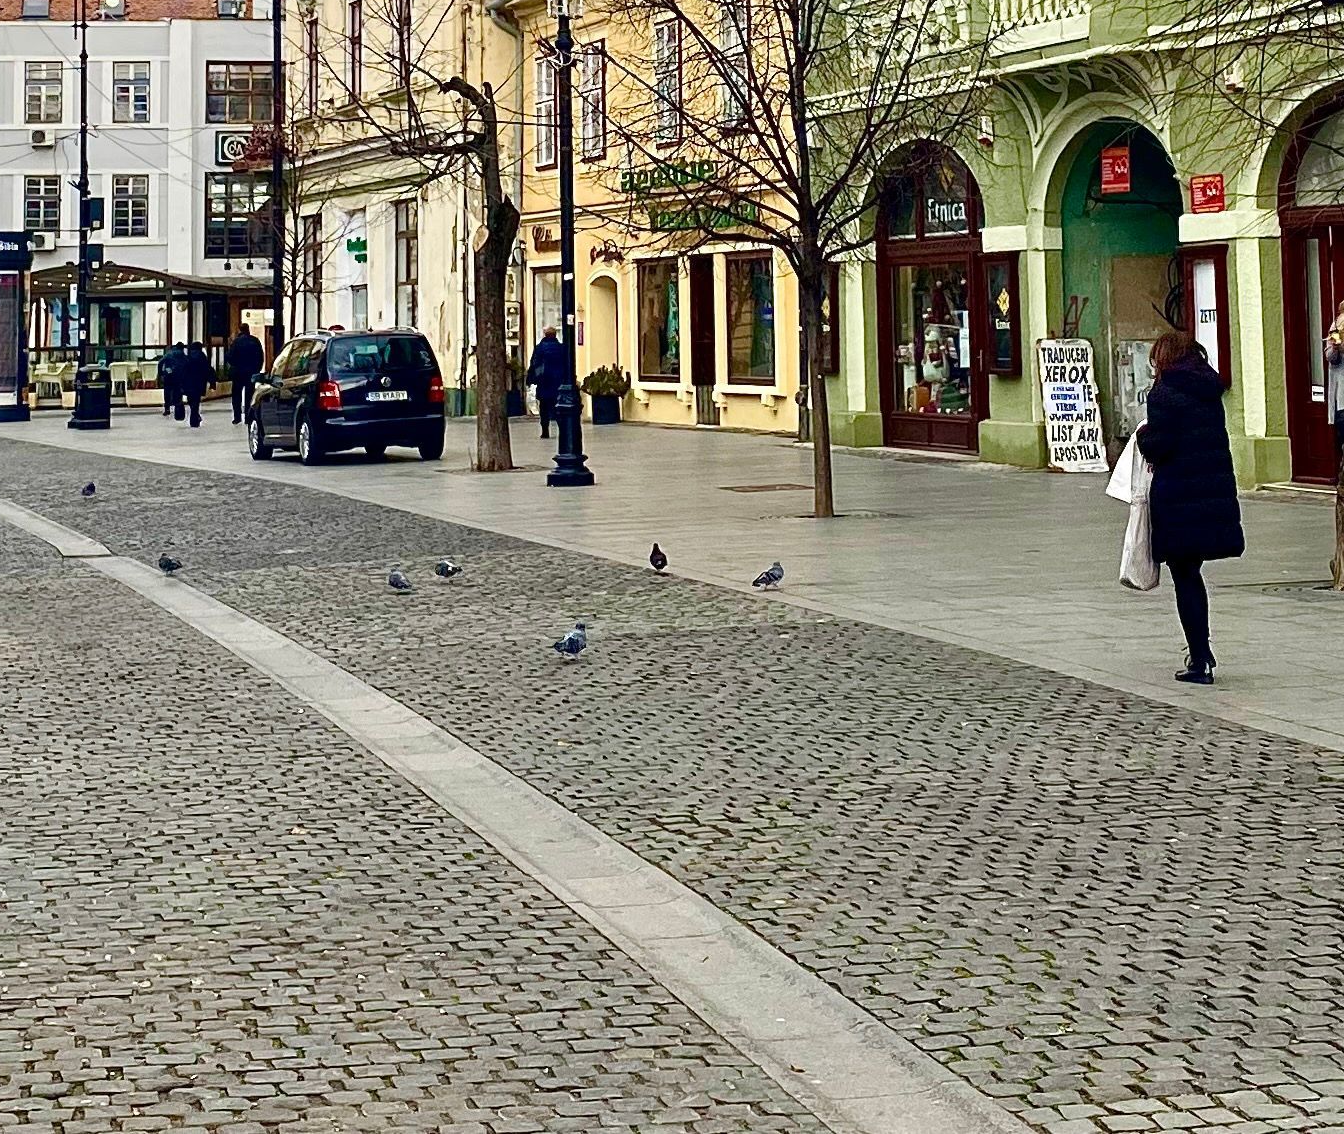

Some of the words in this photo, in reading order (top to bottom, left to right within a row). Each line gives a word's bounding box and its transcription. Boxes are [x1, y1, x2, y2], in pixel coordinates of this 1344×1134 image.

[928, 198, 966, 223] Etnica
[1200, 309, 1217, 323] ZETT
[1041, 347, 1089, 364] TRADUCERI
[1044, 365, 1090, 384] XEROX
